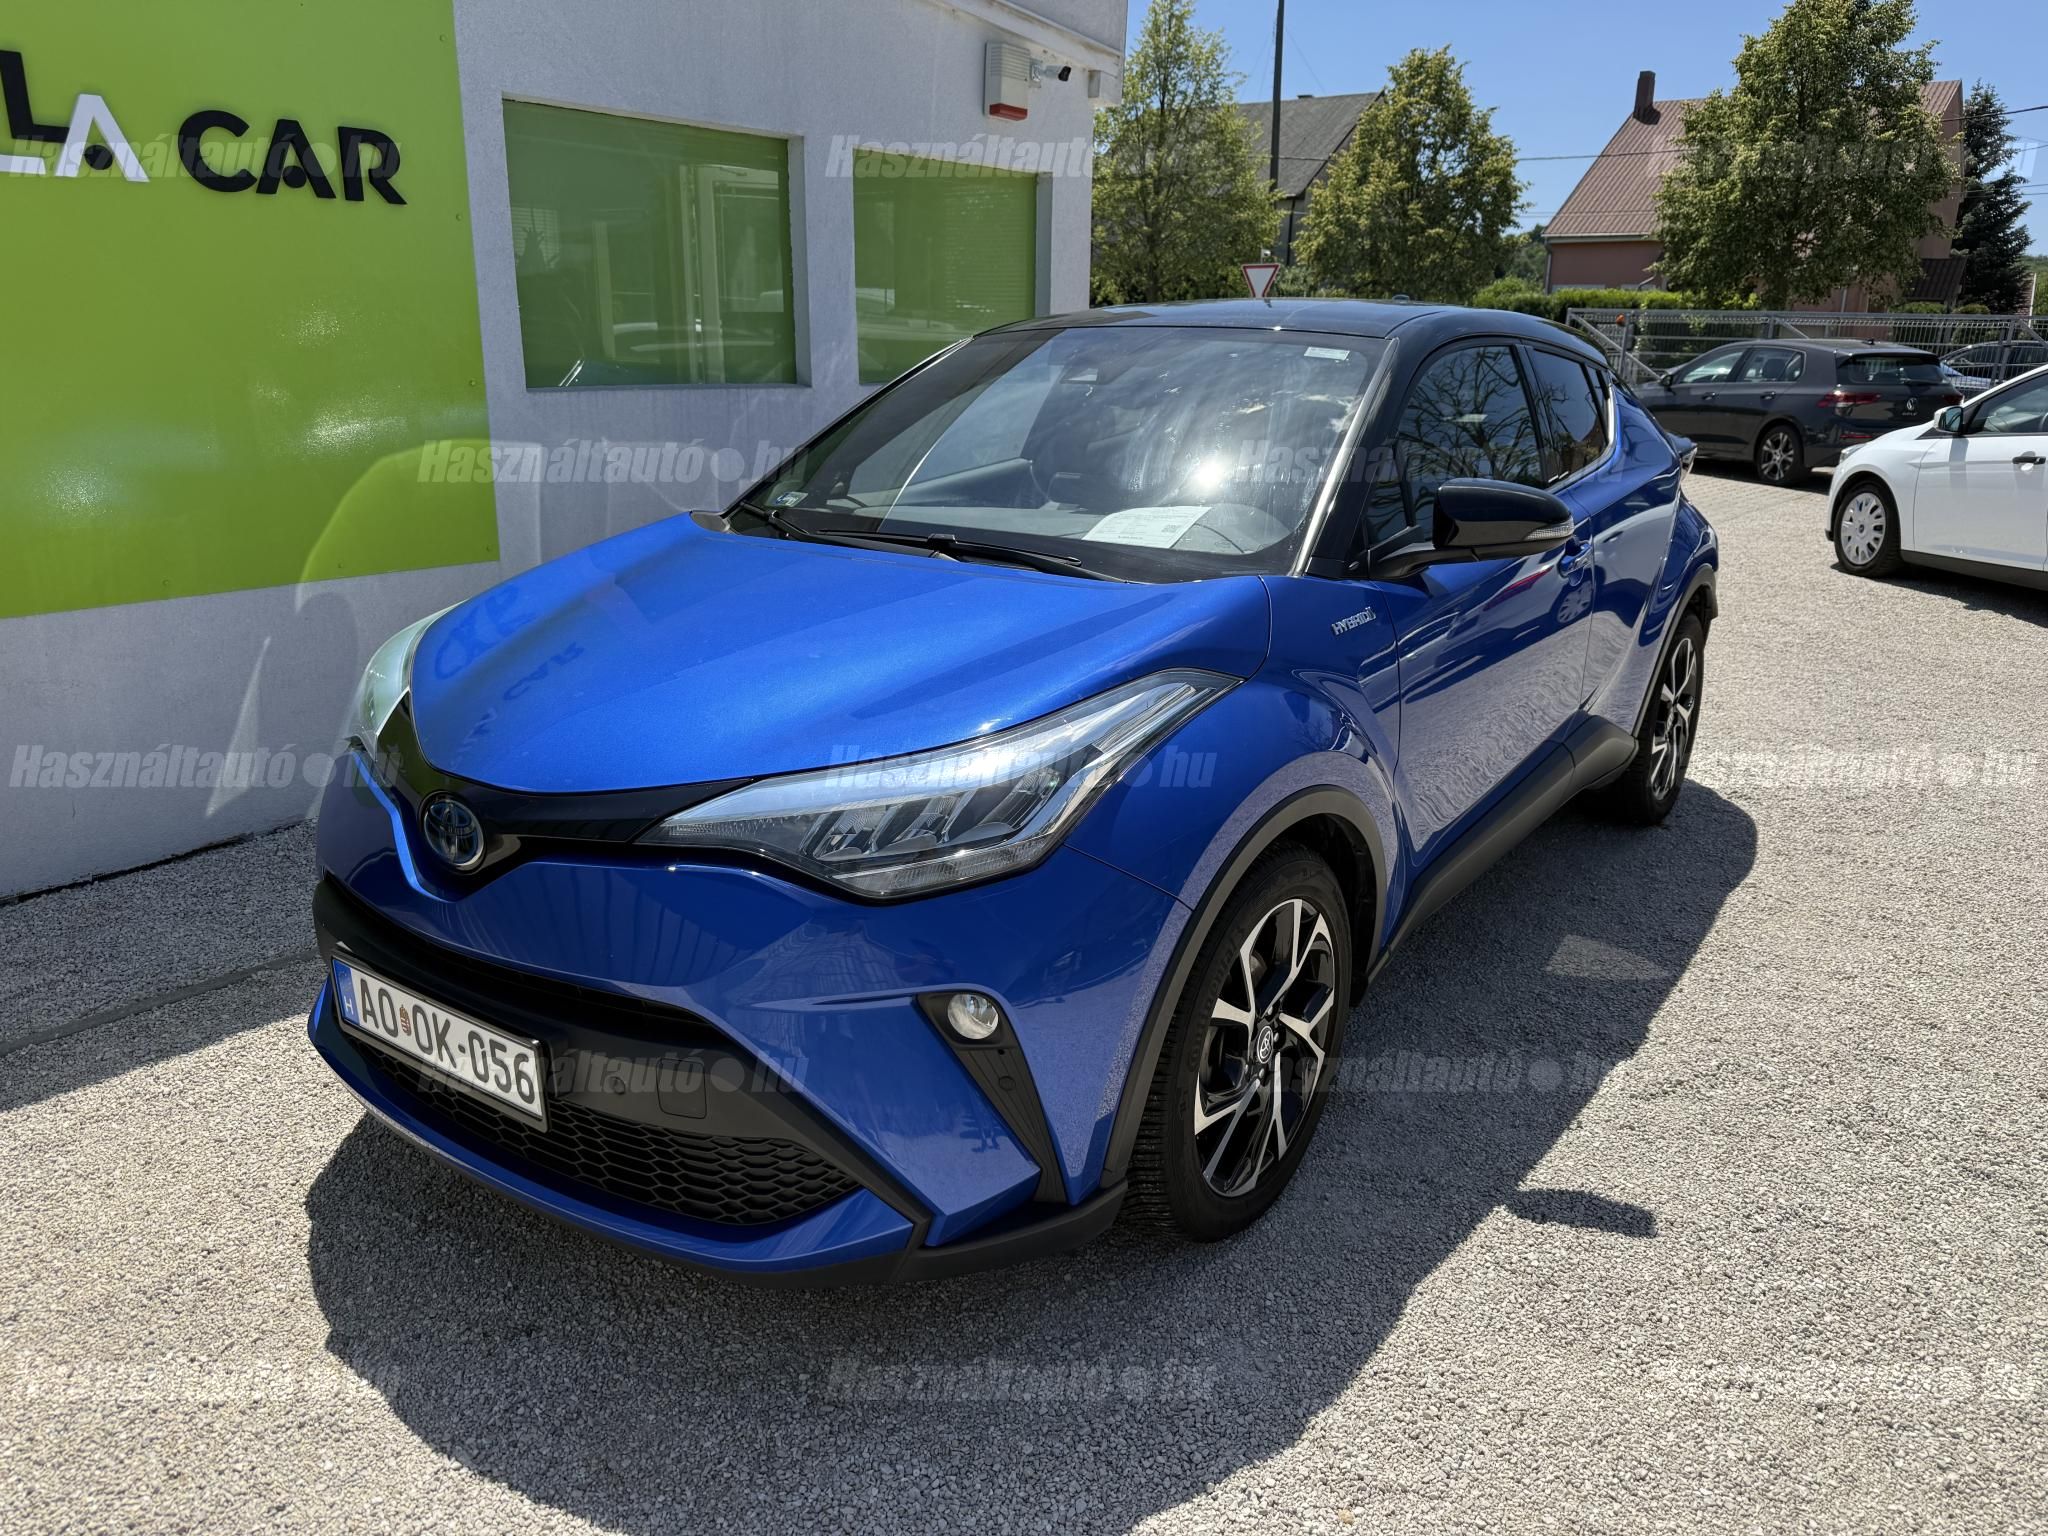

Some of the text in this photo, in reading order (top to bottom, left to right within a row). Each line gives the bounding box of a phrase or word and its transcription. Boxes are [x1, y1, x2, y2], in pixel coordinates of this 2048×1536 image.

[178, 110, 407, 205] CAR
[360, 978, 536, 1105] AO OK-056
